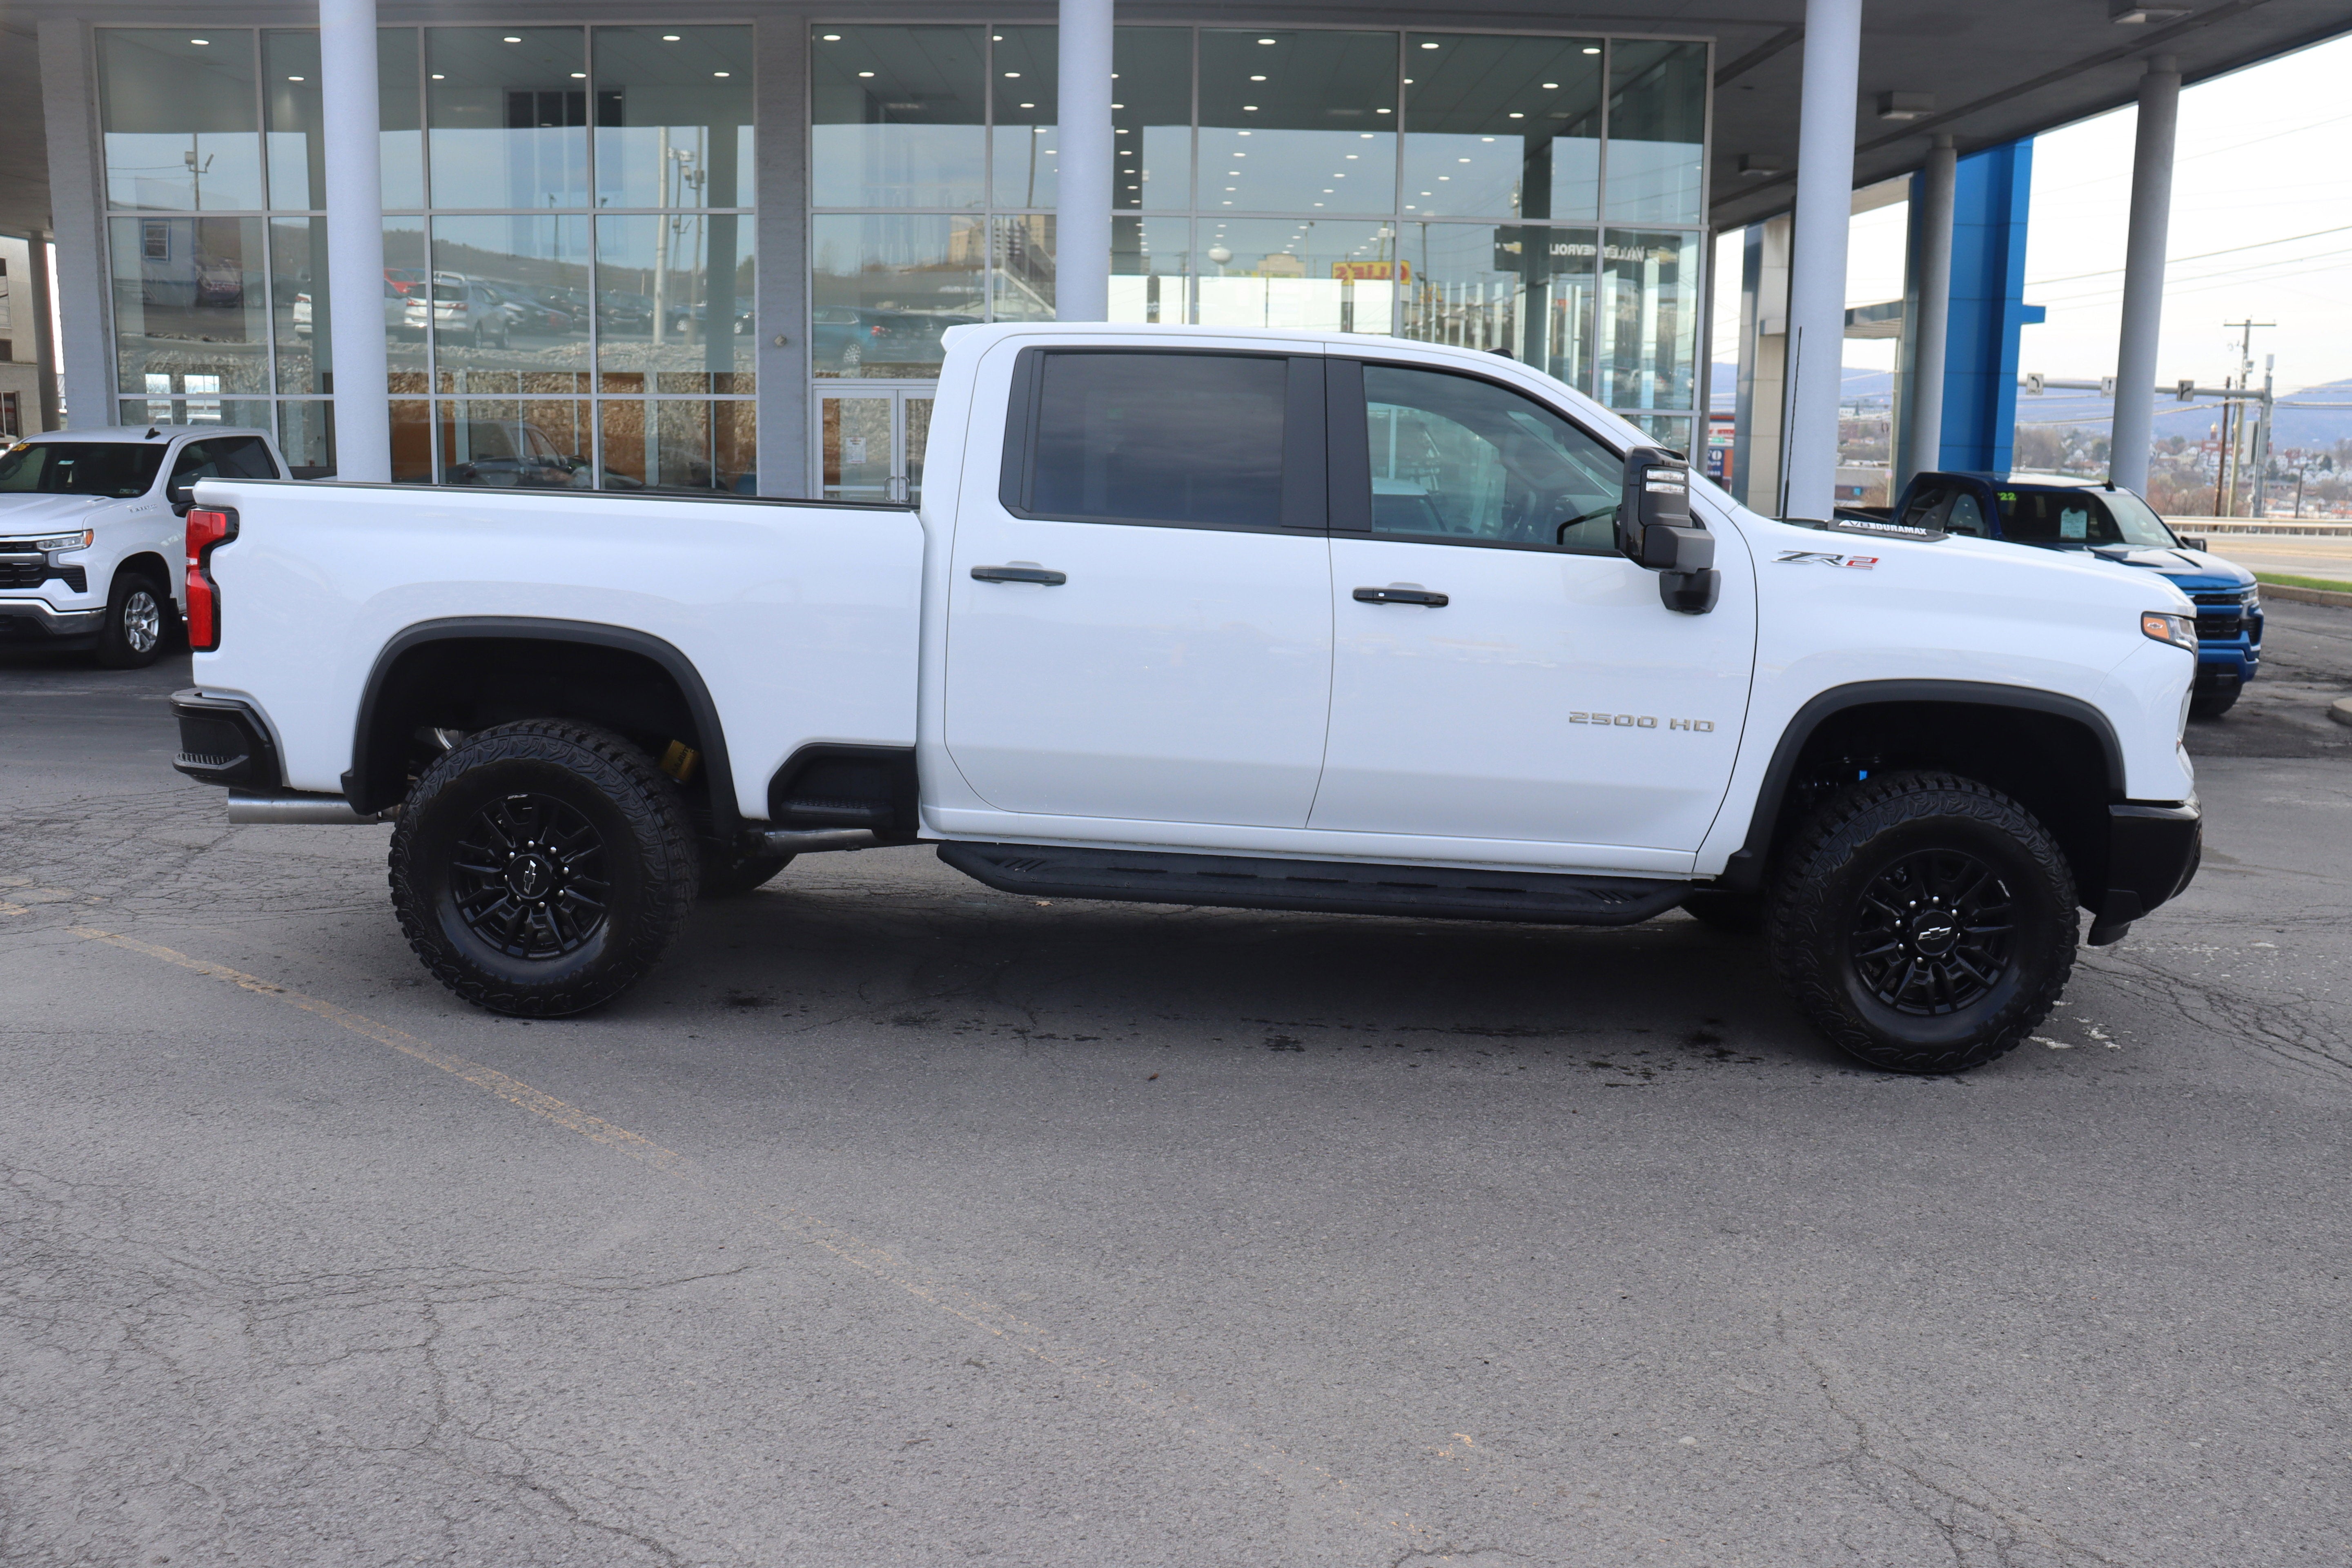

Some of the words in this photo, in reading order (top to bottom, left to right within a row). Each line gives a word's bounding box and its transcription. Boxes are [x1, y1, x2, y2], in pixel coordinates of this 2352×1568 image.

[1875, 523, 1927, 535] DURAMAX
[1771, 550, 1879, 570] ZR2
[1569, 711, 1658, 728] 2500
[1670, 717, 1715, 733] HD
